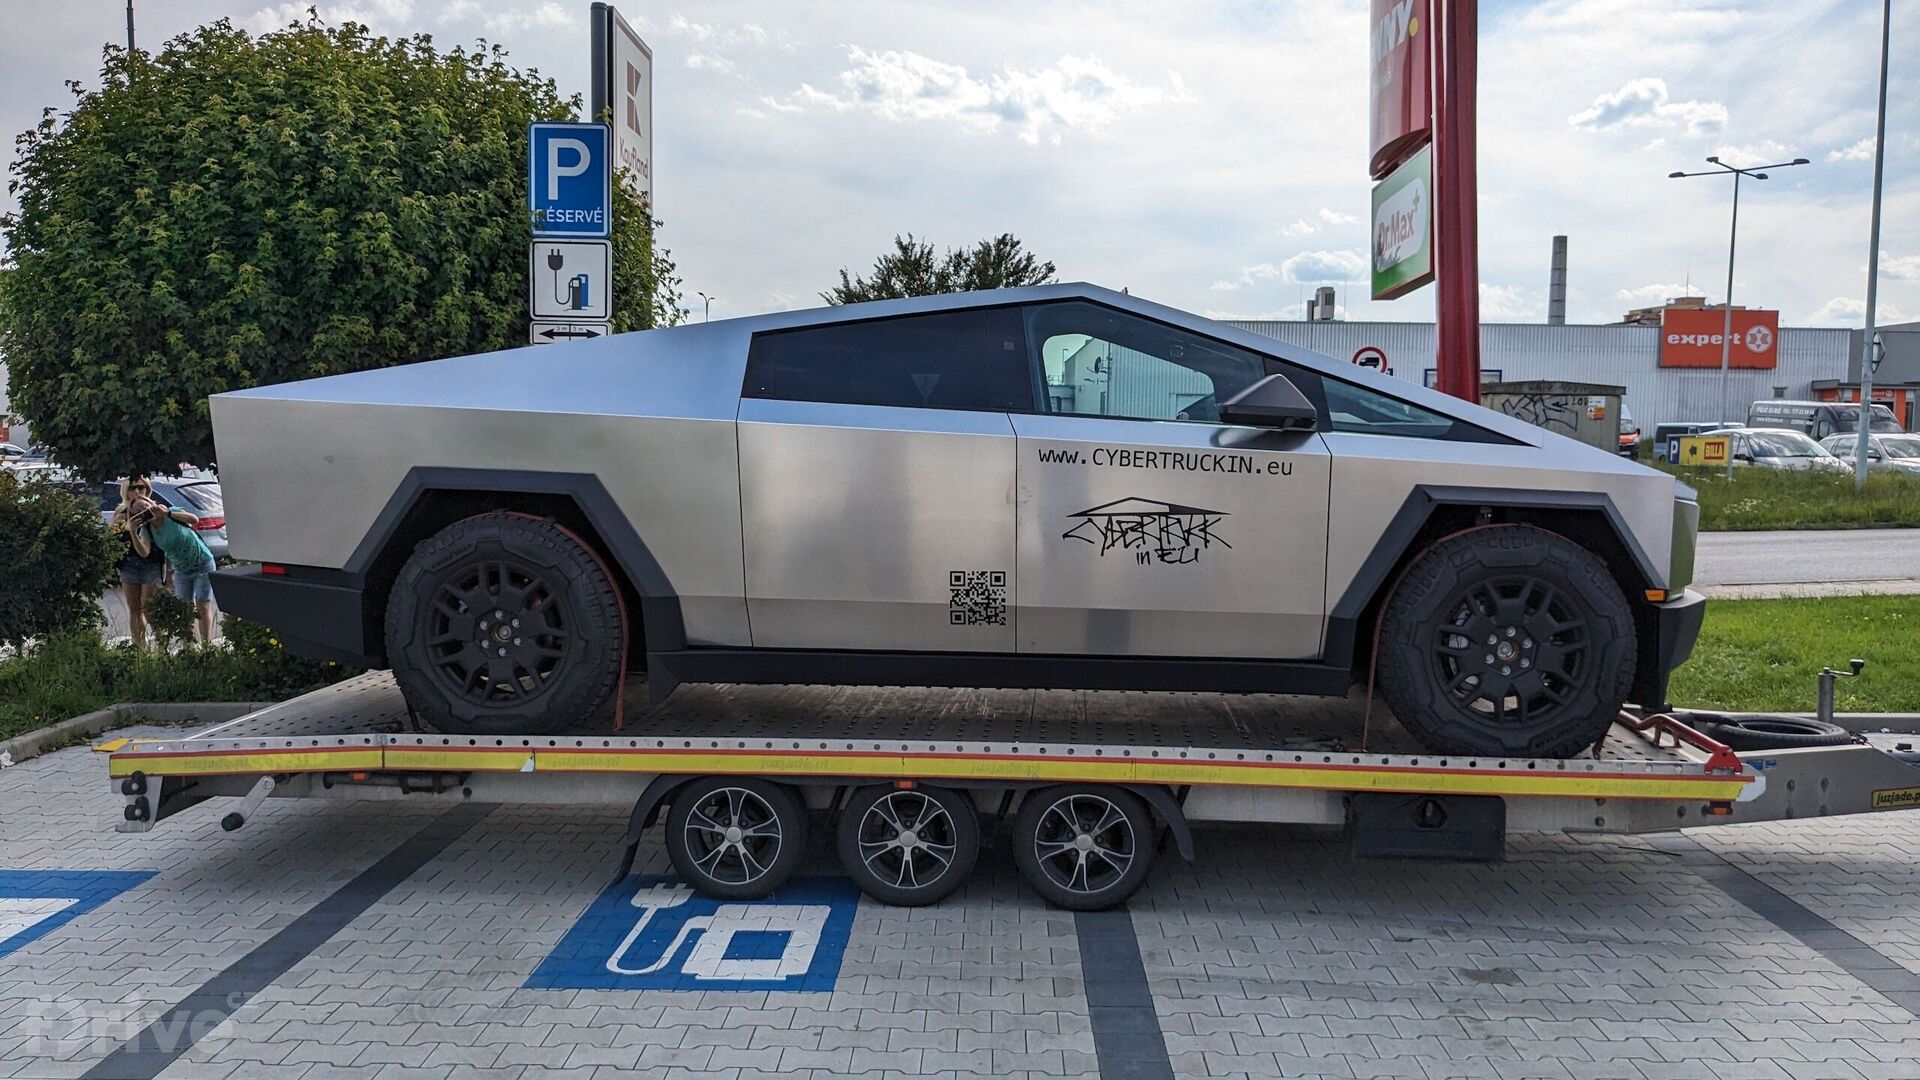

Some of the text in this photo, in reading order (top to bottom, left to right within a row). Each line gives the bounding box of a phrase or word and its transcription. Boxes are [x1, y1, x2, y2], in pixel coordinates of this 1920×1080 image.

[548, 138, 591, 200] P
[619, 136, 649, 180] Kaufland
[1038, 447, 1293, 476] www.CYBERTRUCKIN.eu
[1671, 440, 1679, 461] P
